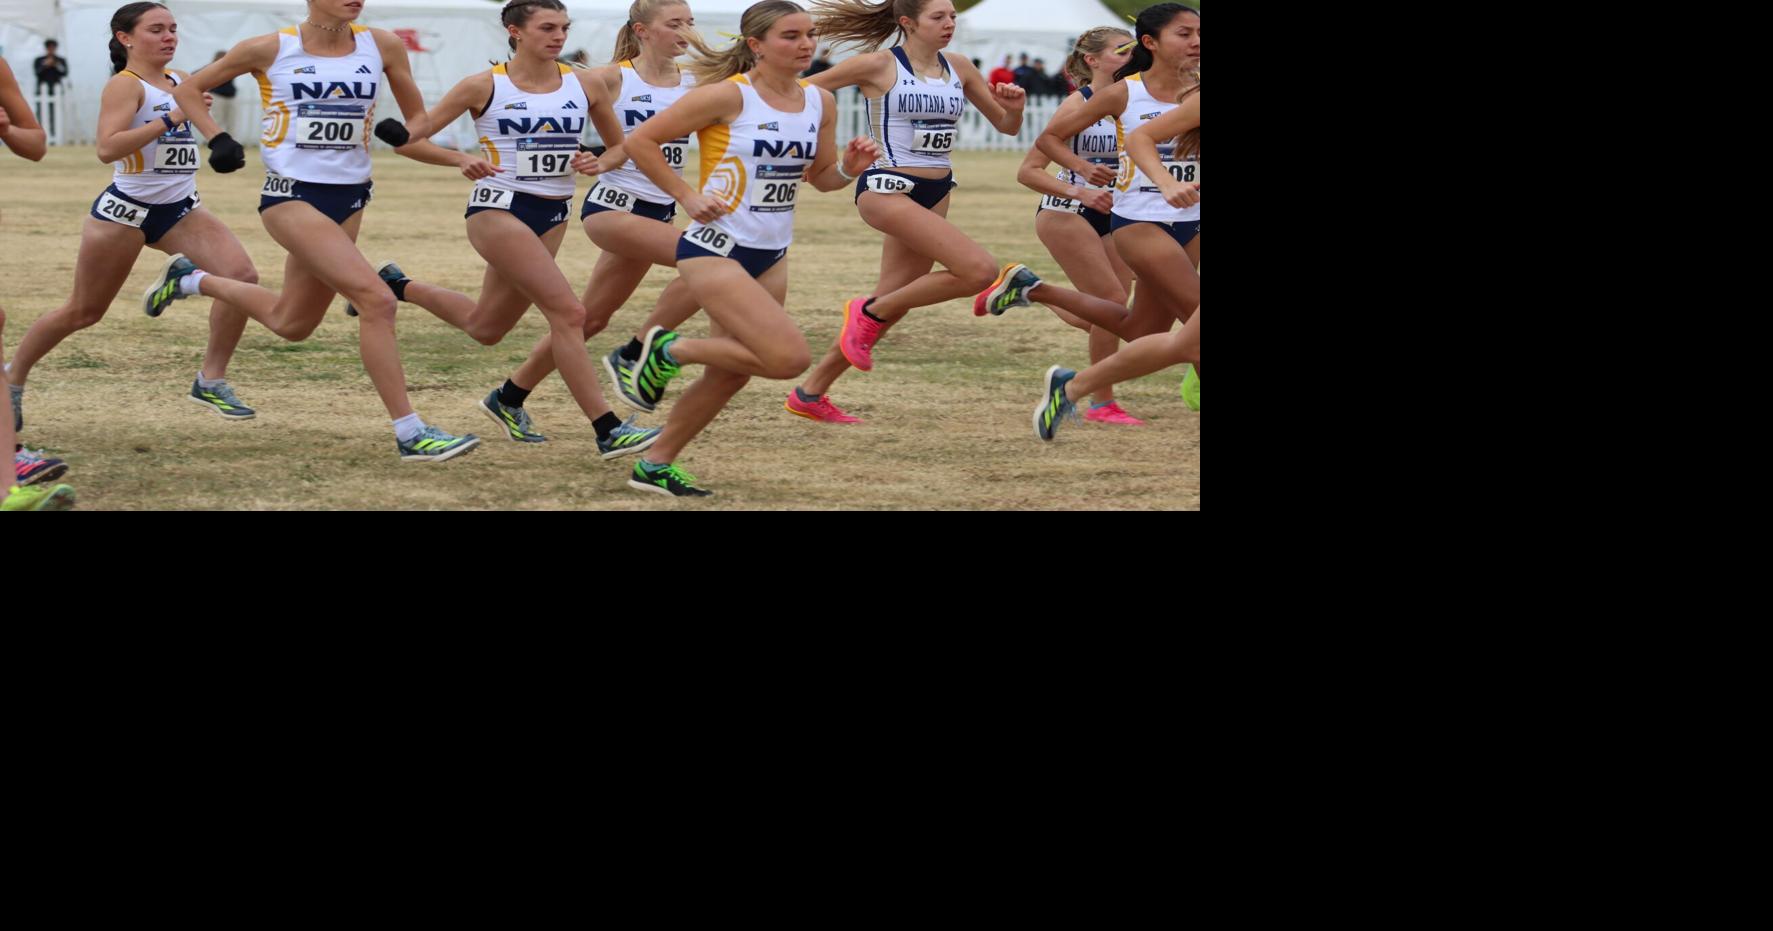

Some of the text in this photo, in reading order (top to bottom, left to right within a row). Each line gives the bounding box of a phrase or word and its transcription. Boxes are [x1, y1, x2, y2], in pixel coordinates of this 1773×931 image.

[291, 82, 376, 99] NAU
[898, 94, 945, 113] MONTANA
[308, 121, 354, 141] 200
[497, 117, 585, 135] NAU
[922, 132, 952, 149] 165
[1082, 134, 1118, 152] MONTA
[165, 147, 196, 166] 204
[528, 154, 570, 173] 197
[662, 146, 682, 164] 98
[1169, 164, 1195, 182] 08
[263, 176, 290, 193] 200
[763, 182, 797, 203] 206
[874, 177, 906, 190] 165
[473, 188, 504, 203] 197
[597, 186, 629, 207] 198
[102, 199, 138, 222] 204
